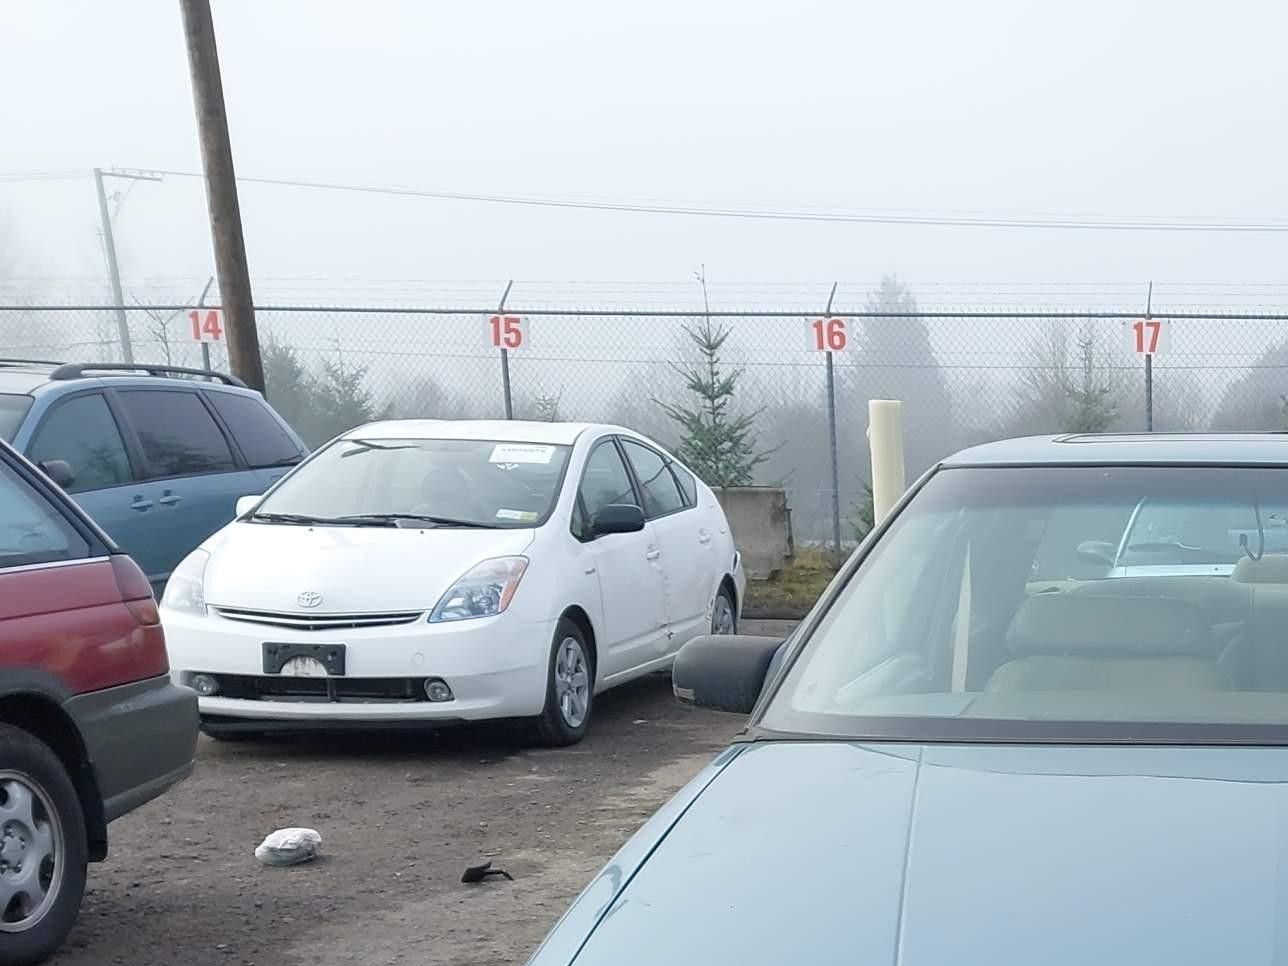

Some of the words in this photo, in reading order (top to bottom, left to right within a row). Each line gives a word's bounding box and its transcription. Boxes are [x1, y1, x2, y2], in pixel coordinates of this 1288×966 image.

[189, 310, 222, 340] 14
[490, 316, 522, 348] 15
[813, 319, 846, 350] 16
[1133, 321, 1161, 352] 17
